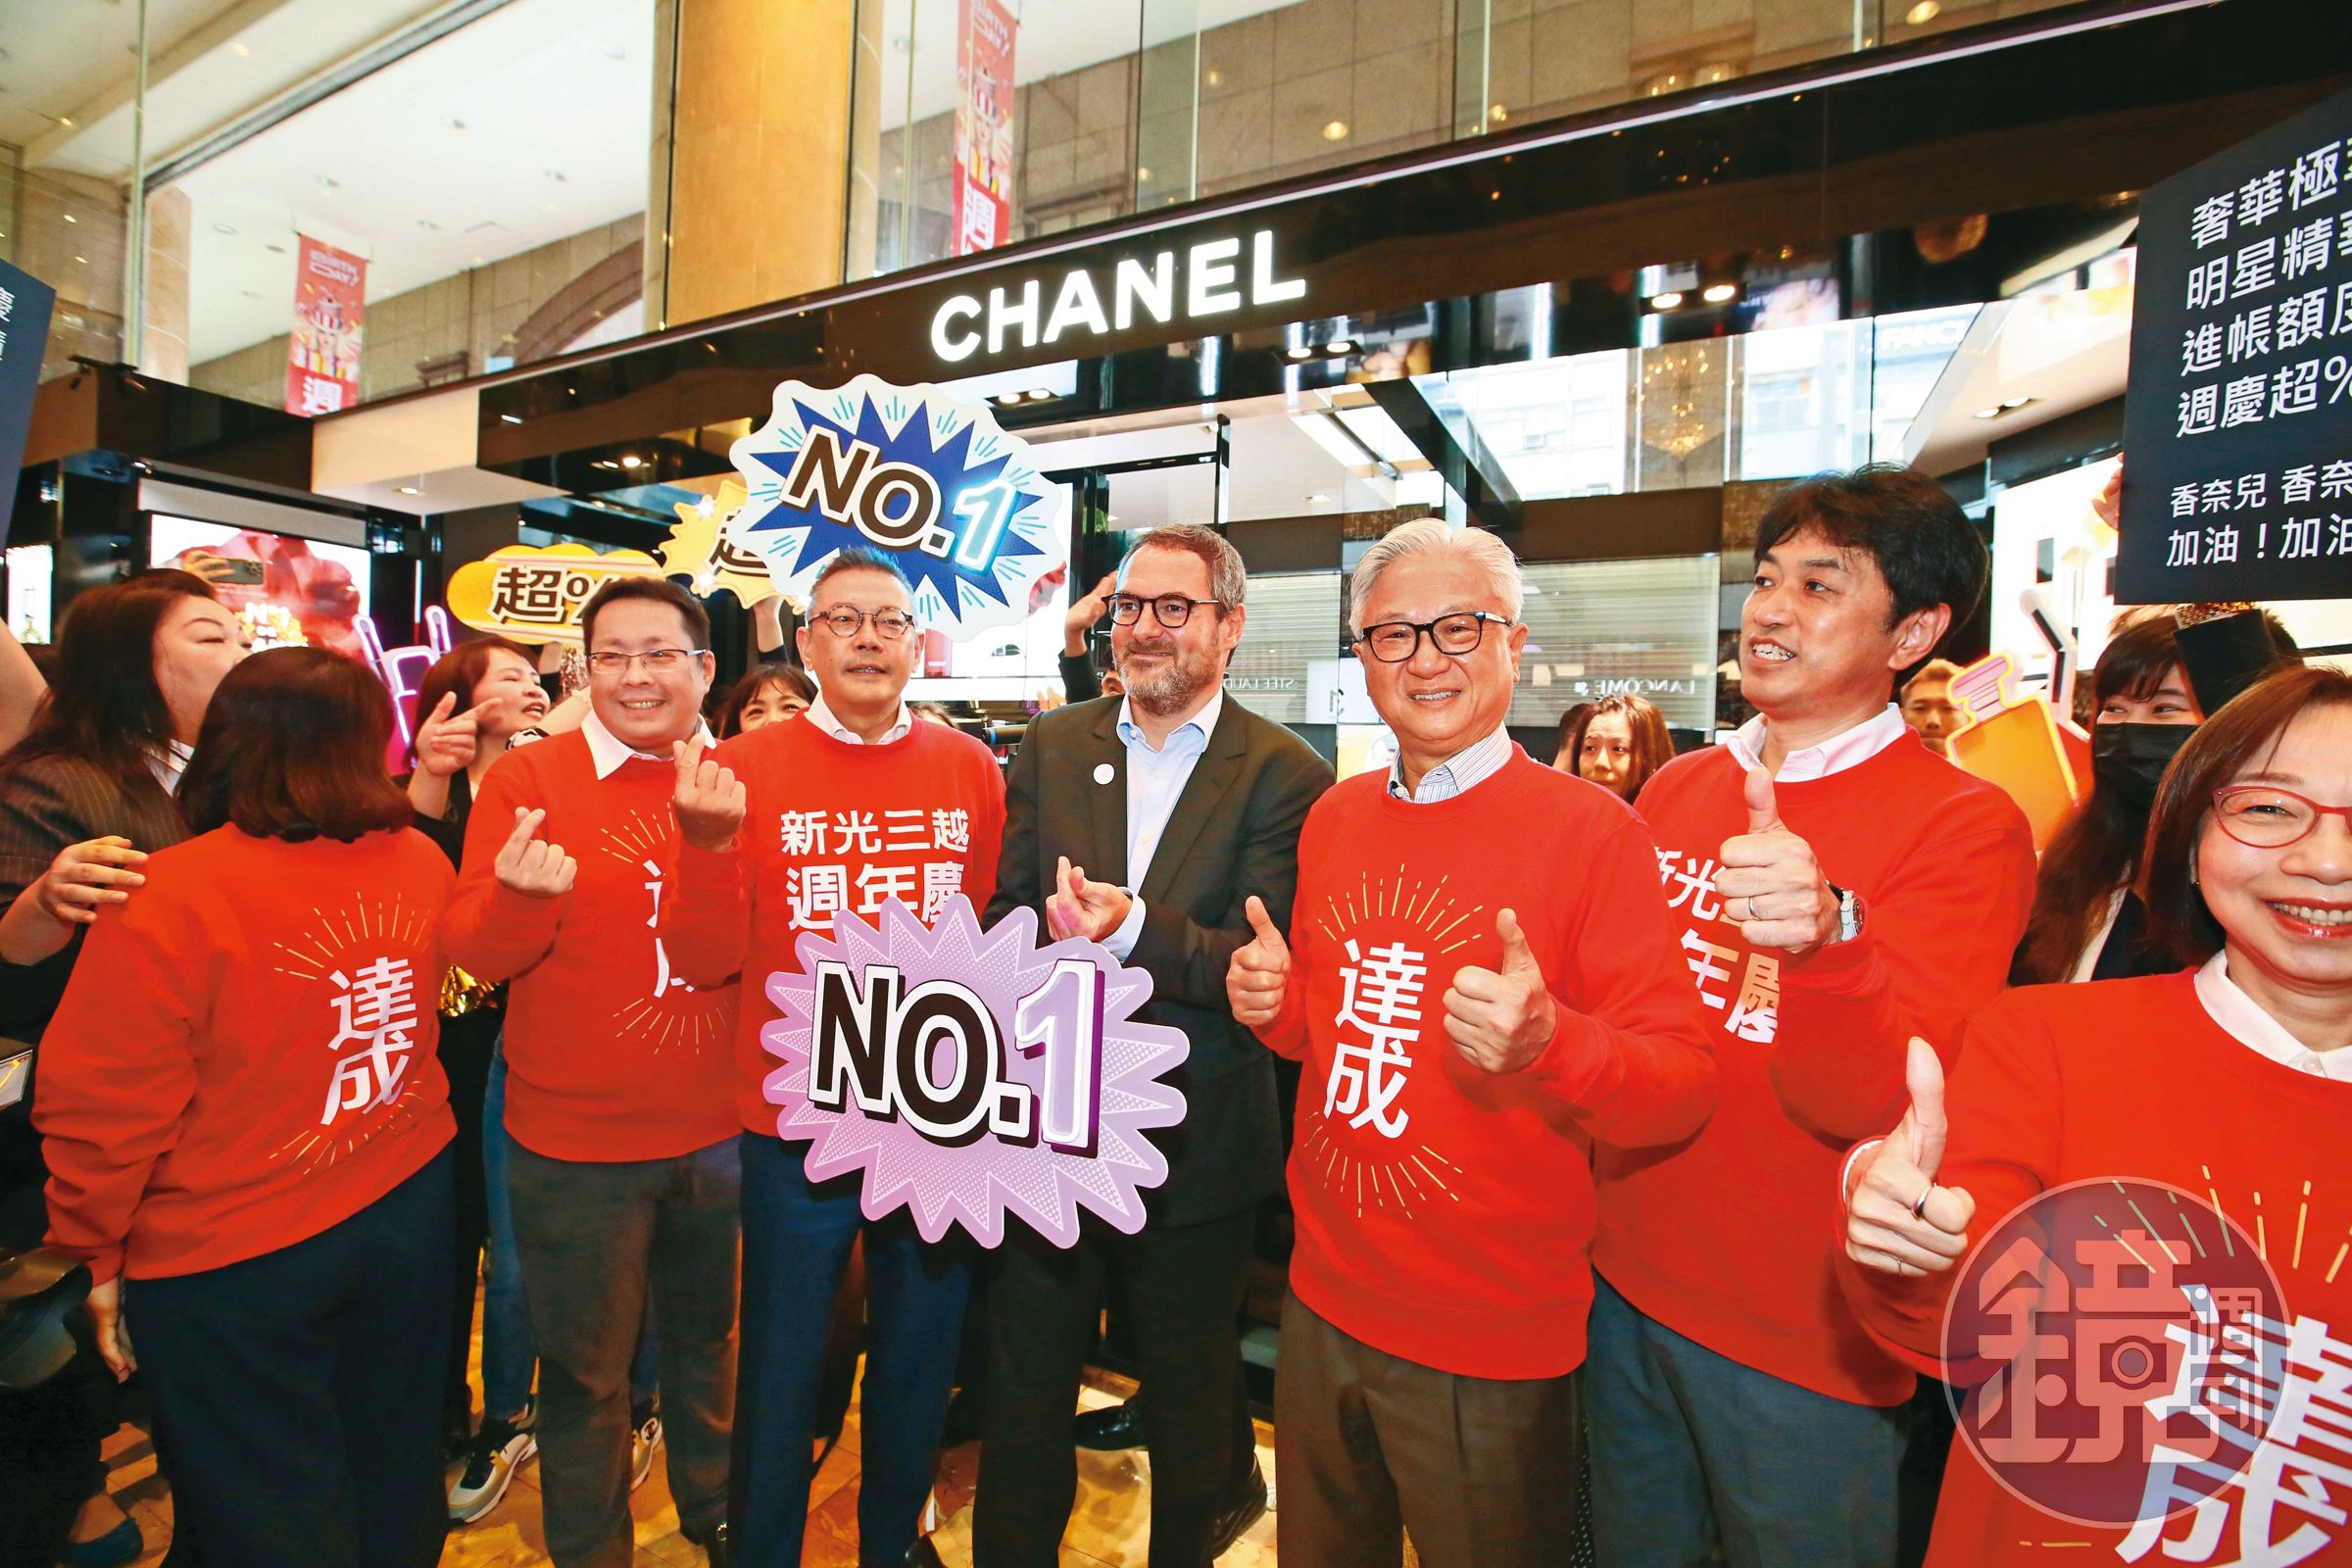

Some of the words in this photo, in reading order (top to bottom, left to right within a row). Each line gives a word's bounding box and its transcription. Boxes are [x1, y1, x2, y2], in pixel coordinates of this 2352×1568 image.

[965, 182, 997, 254] 週
[2191, 137, 2352, 250] 奢華極
[931, 229, 1305, 363] CHANEL
[778, 424, 1021, 574] NO.1
[2170, 472, 2267, 518] 香奈兒
[780, 808, 969, 857] 新光三越
[785, 860, 965, 931] 週年慶
[320, 956, 417, 1126] 達成
[808, 958, 1104, 1158] NO.1
[1323, 938, 1427, 1139] 達成
